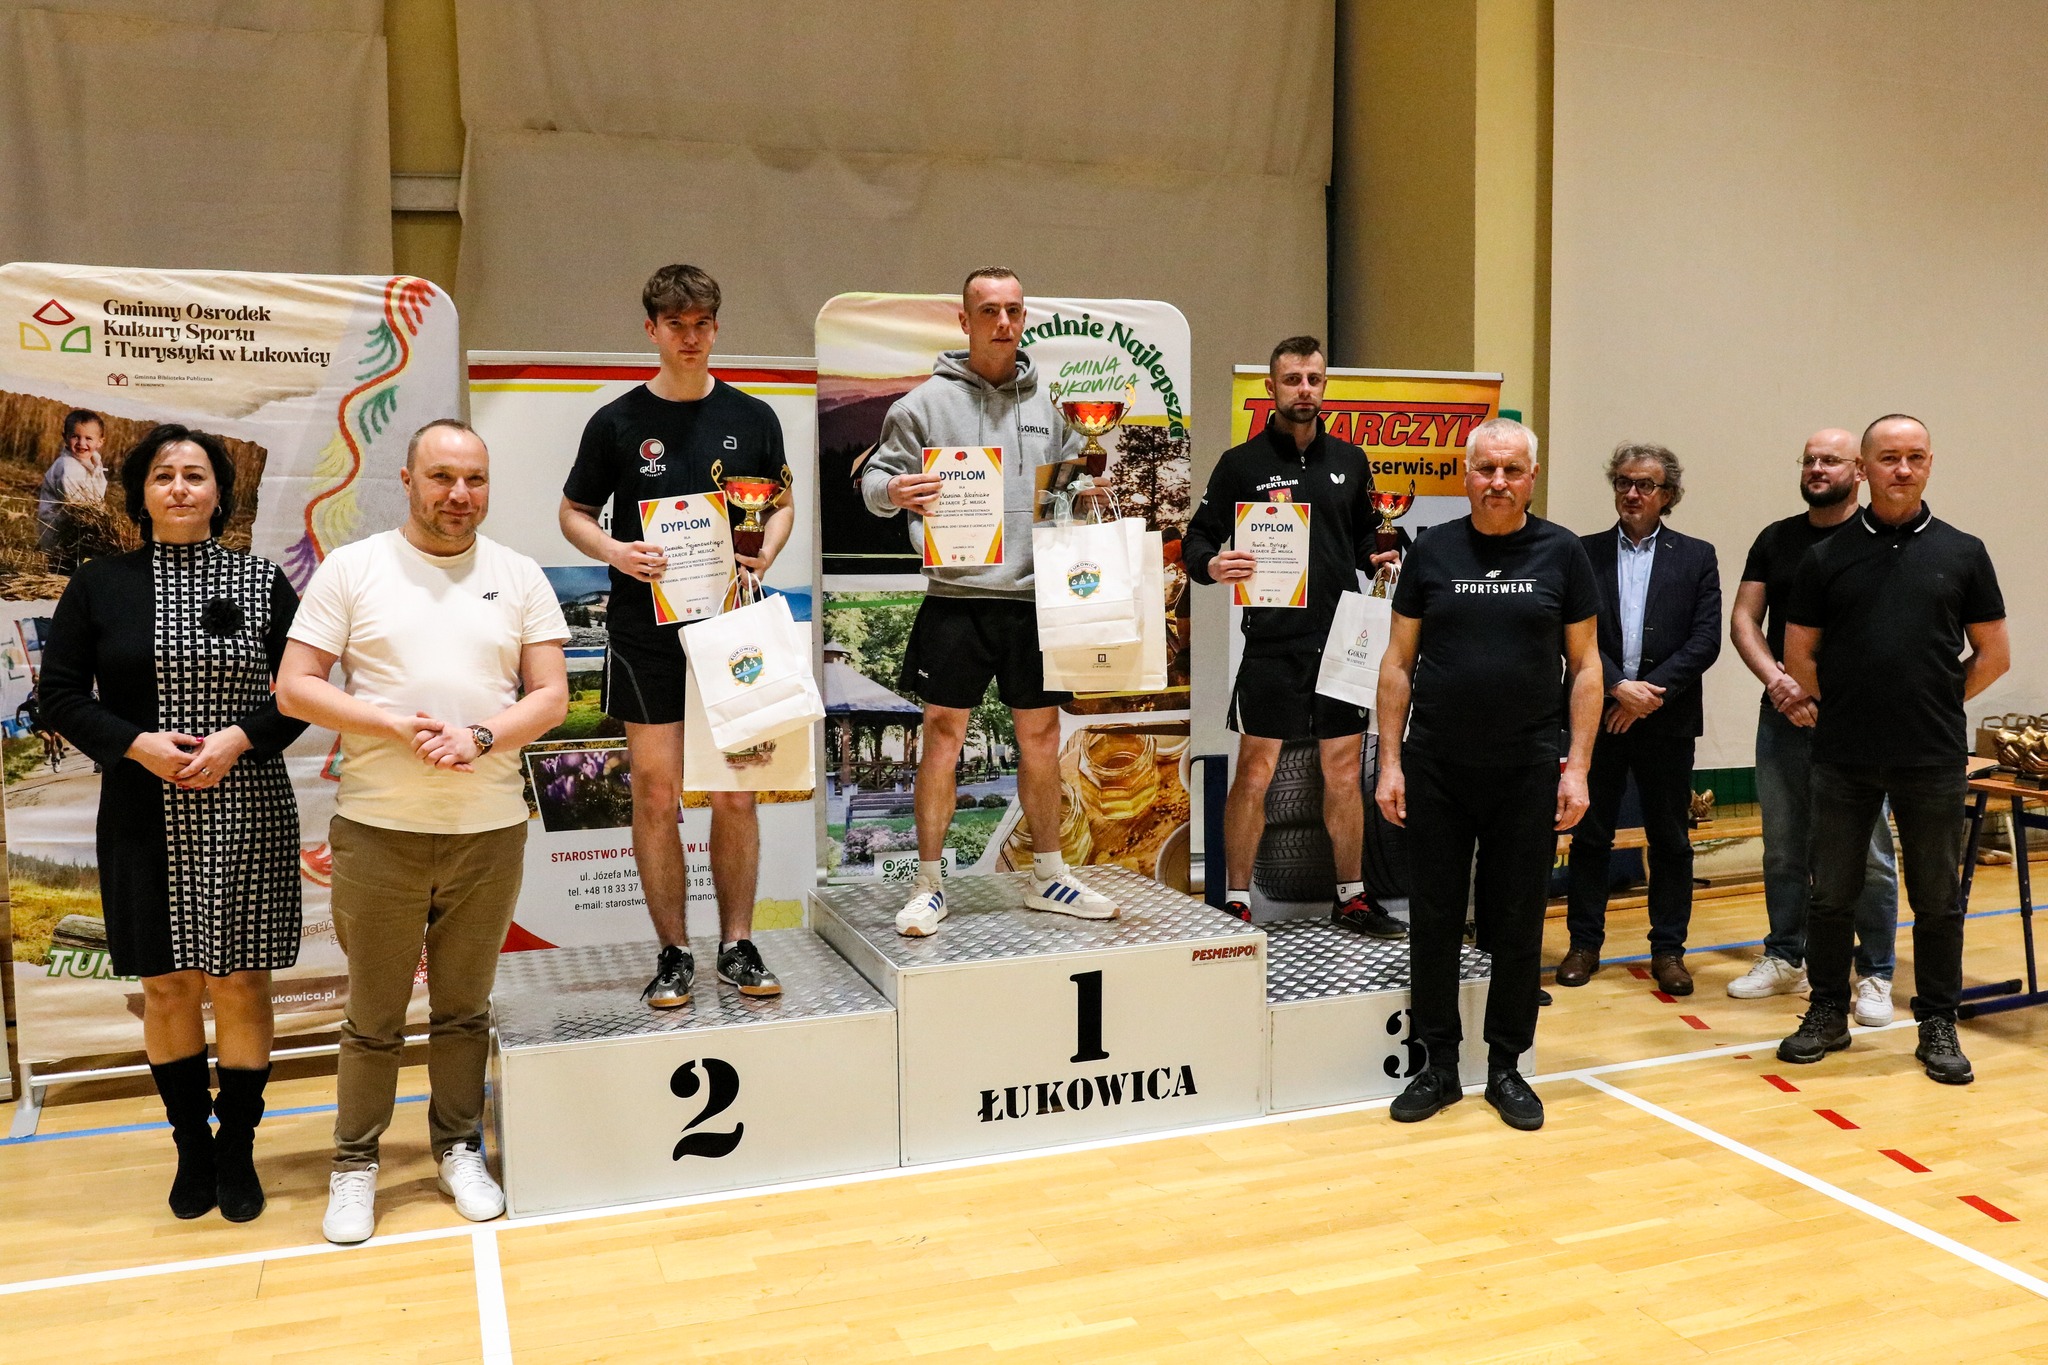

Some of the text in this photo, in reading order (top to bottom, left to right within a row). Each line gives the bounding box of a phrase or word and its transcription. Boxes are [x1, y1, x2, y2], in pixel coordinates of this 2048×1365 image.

[103, 300, 270, 322] Gminny Ośrodek
[104, 320, 254, 343] Kultury Sportu
[104, 341, 330, 367] i Turystyki w Łukowicy
[1017, 313, 1184, 438] uralnie Najlepsza
[1060, 355, 1121, 378] GMINA
[1018, 425, 1049, 434] GORLICE
[1244, 398, 1489, 447] TARCZYK
[940, 470, 986, 480] DYPLOM
[1368, 457, 1457, 480] serwis.pl
[1256, 479, 1298, 491] SPEKTRUM
[661, 518, 711, 533] DYPLOM
[1251, 524, 1293, 532] DYPLOM
[1485, 570, 1502, 578] 4F
[482, 592, 498, 600] 4F
[1455, 583, 1533, 594] SPORTSWEAR
[551, 843, 710, 862] STAROSTWO PO W LI
[580, 872, 590, 881] ul.
[593, 870, 621, 880] Józefa
[624, 869, 639, 878] Mar
[692, 864, 712, 872] Lima
[568, 887, 581, 897] tel.
[584, 886, 600, 895] +48
[603, 885, 613, 894] 18
[616, 884, 626, 892] 33
[628, 883, 638, 892] 37
[694, 878, 704, 886] 18
[575, 901, 603, 910] e-mail:
[606, 898, 647, 909] starostwo
[271, 989, 336, 1004] ukowica.pl
[1069, 970, 1110, 1063] 1
[1383, 1008, 1428, 1079] 3
[978, 1064, 1197, 1122] ŁUKOWICA
[670, 1058, 744, 1161] 2
